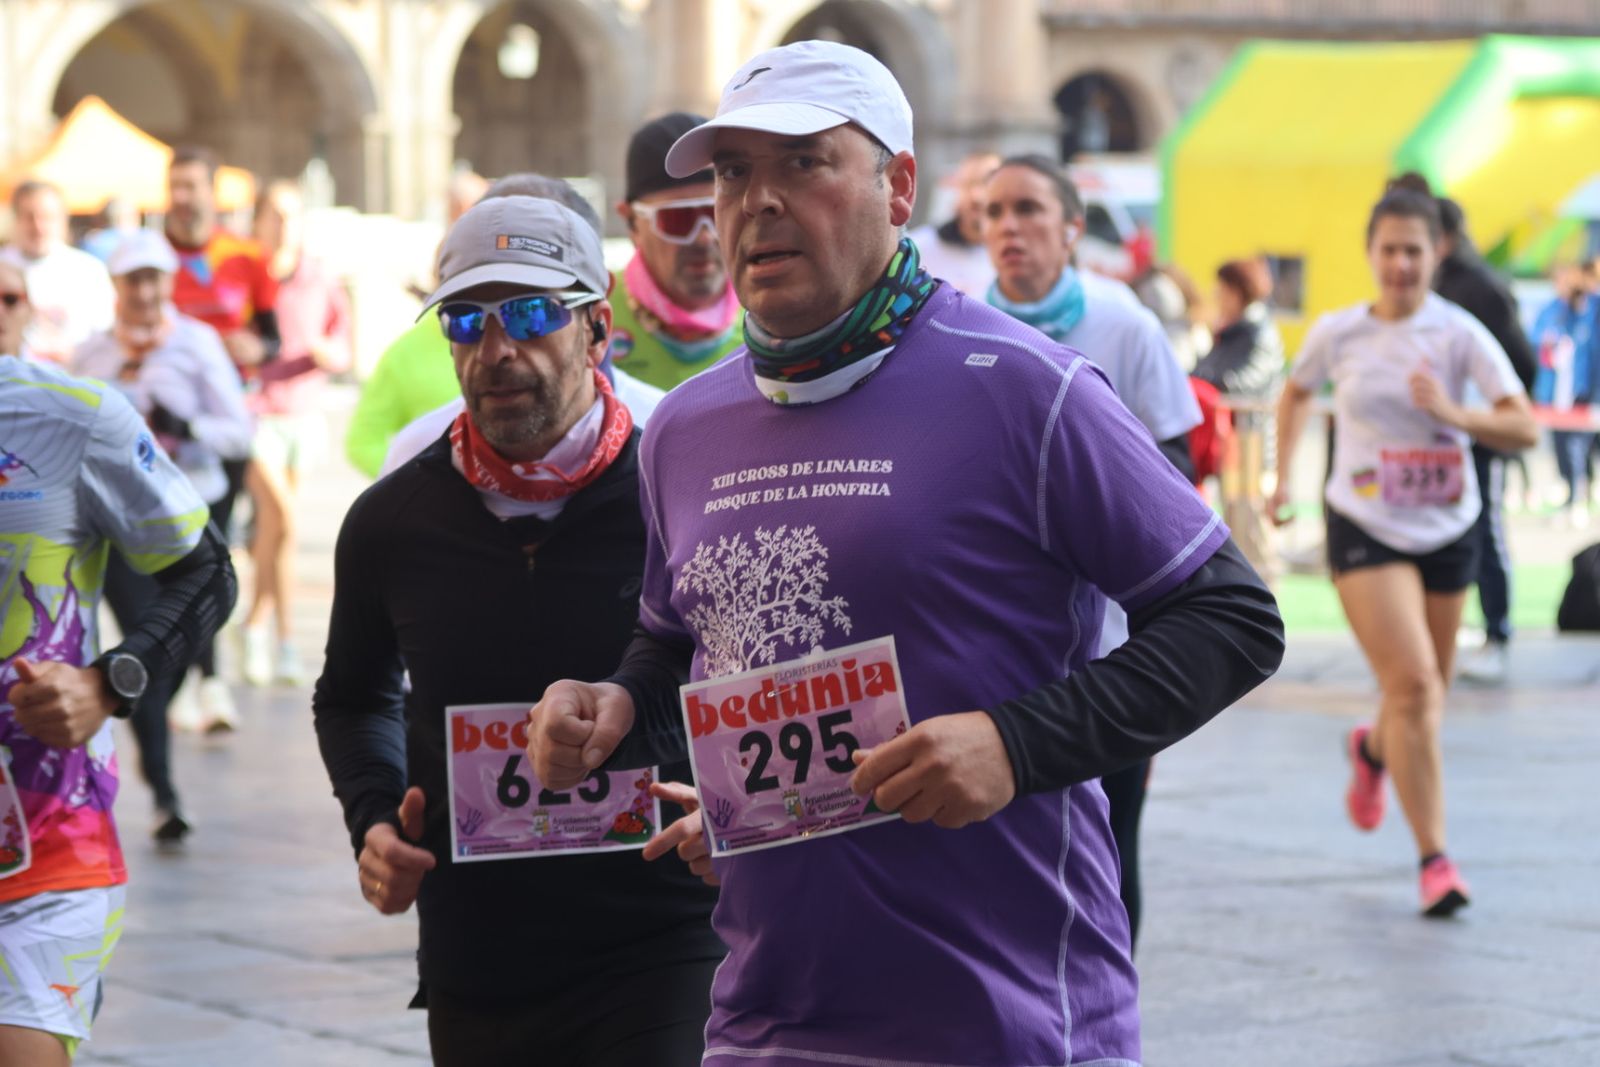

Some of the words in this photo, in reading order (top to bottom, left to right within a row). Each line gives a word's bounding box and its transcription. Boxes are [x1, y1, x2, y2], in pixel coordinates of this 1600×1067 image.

[711, 472, 737, 491] XIII
[737, 464, 789, 484] CROSS
[791, 461, 814, 477] DE
[816, 459, 893, 475] LINARES
[704, 491, 761, 515] BOSQUE
[763, 487, 785, 503] DE
[787, 484, 808, 500] LA
[811, 482, 892, 498] HONFRIA
[774, 658, 838, 683] FLORISTERÍAS
[685, 658, 897, 739] bedunia
[739, 709, 861, 796] 295
[804, 786, 854, 807] Ayuntamient
[818, 797, 861, 815] Salamanca
